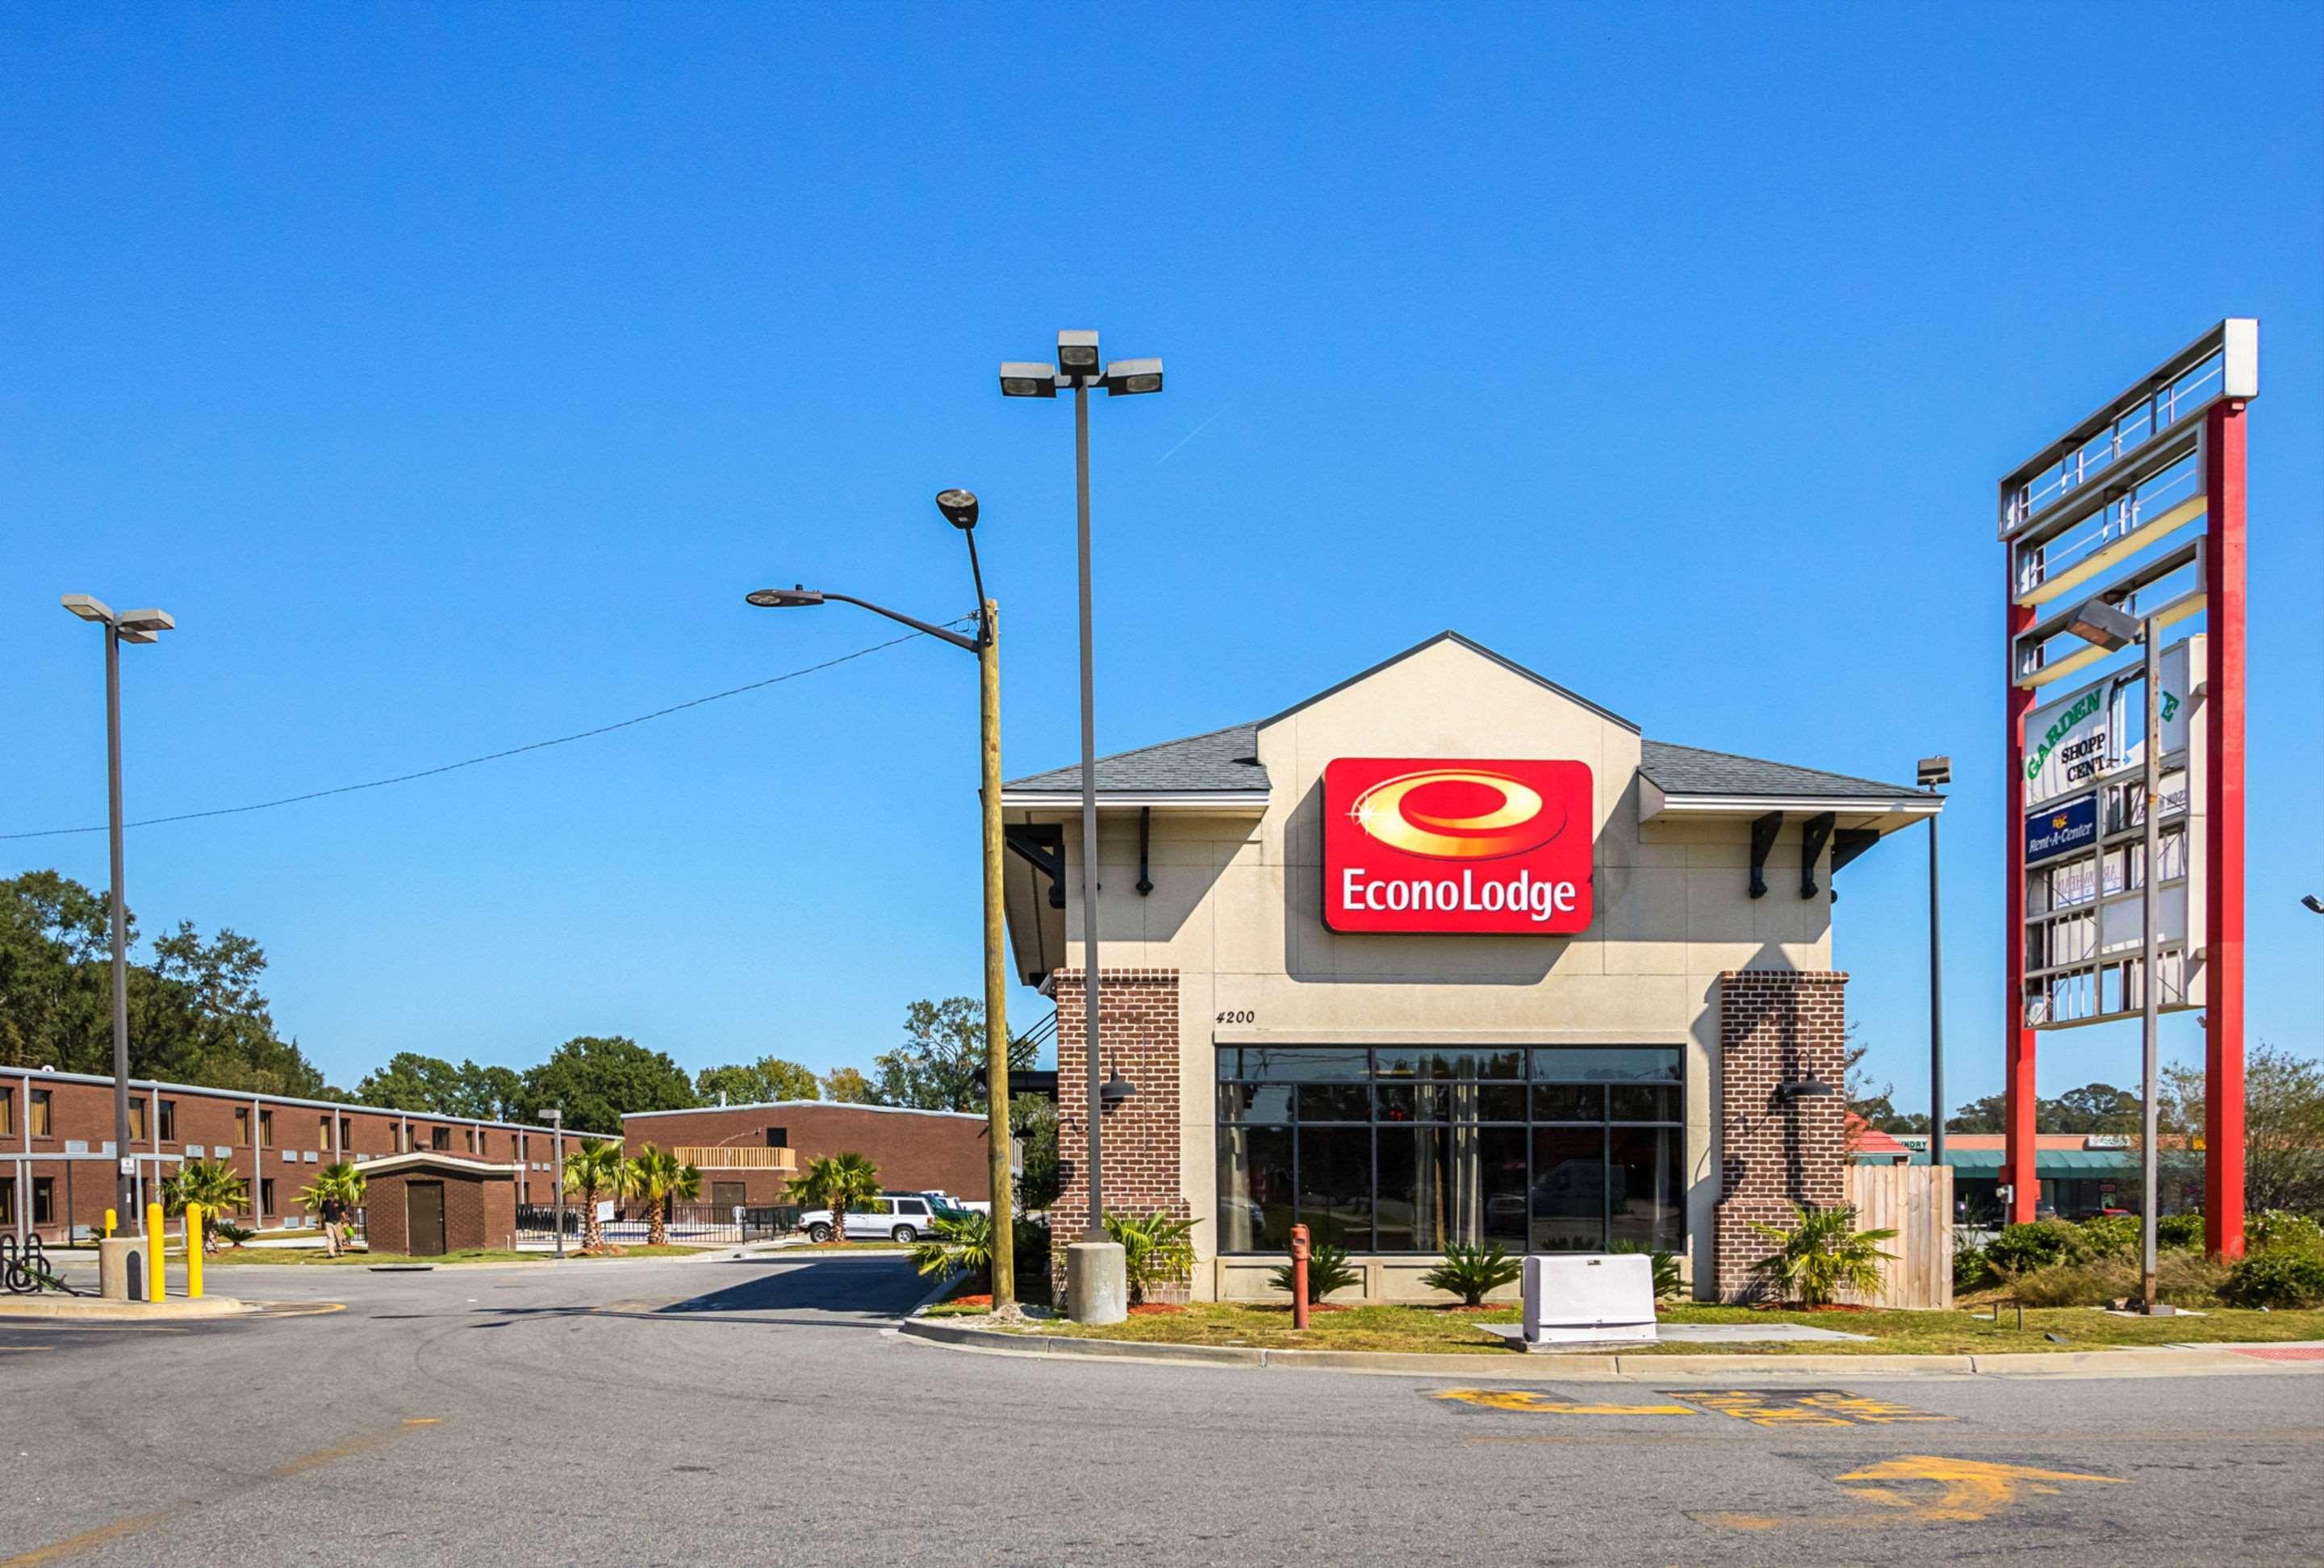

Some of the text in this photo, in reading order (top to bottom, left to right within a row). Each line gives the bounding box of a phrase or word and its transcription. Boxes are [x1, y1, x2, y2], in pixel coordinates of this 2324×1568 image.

[2026, 688, 2102, 780] GARDEN
[2060, 732, 2105, 765] SHOPP
[2067, 755, 2105, 783] CENT
[1343, 868, 1576, 922] EconoLodge
[1216, 1010, 1255, 1024] 4200
[1902, 1140, 1927, 1148] NDRY
